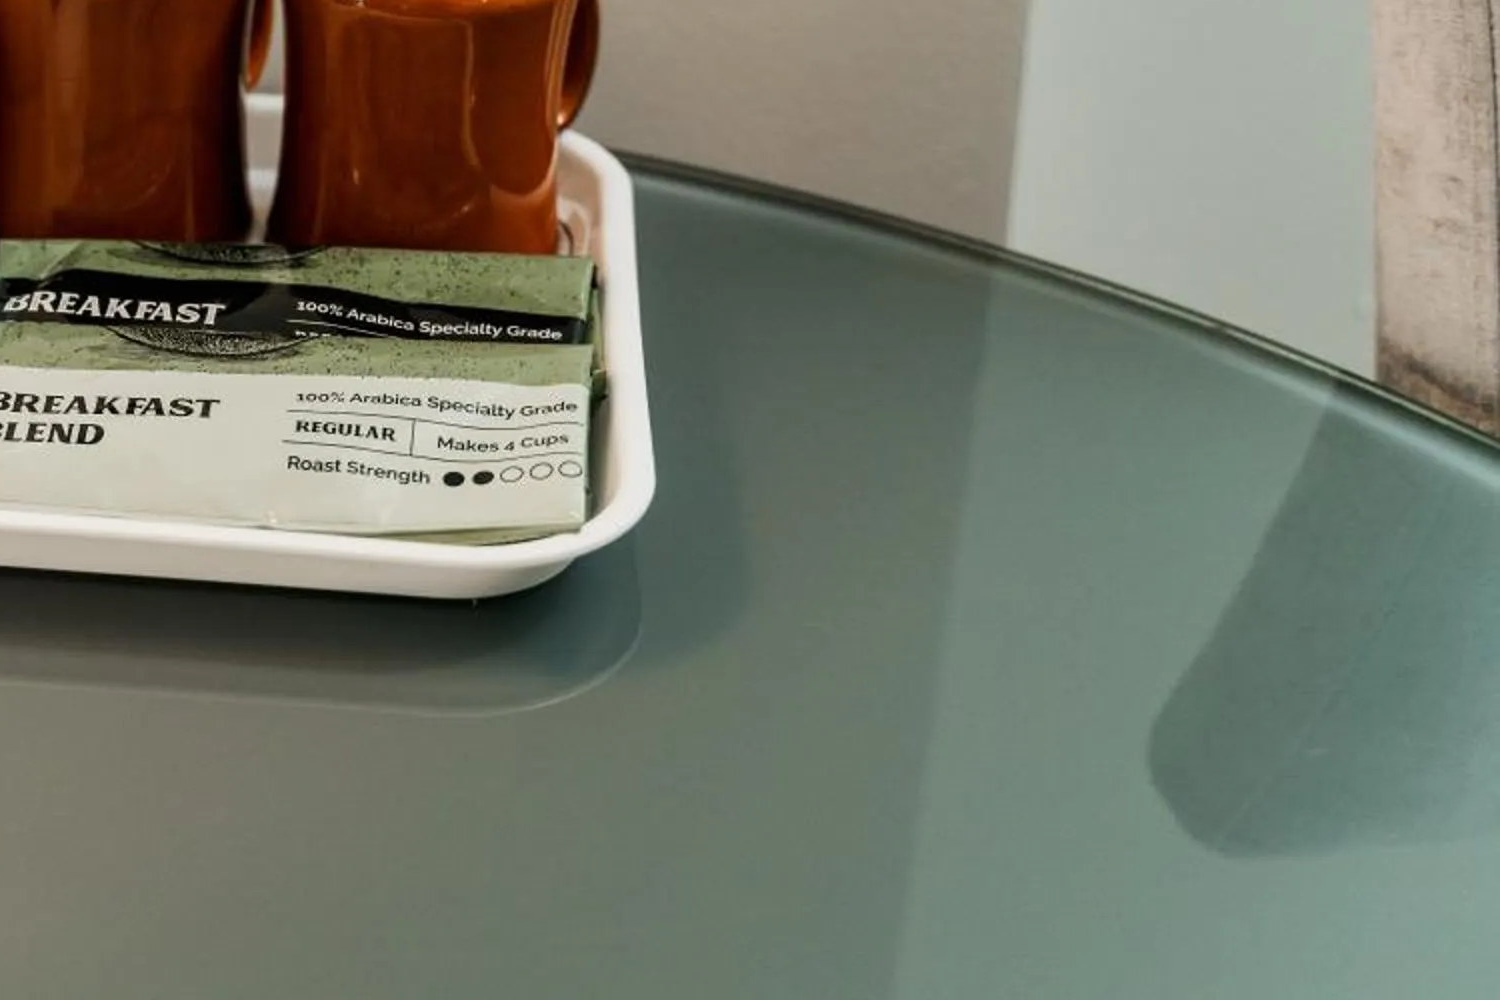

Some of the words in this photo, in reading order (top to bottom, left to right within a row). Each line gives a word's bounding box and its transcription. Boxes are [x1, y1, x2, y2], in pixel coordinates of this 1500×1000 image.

[3, 290, 226, 325] BREAKFAST
[296, 301, 343, 317] 100%
[346, 308, 415, 331] Arabica
[419, 320, 503, 338] Specialty
[506, 324, 563, 341] Grade
[296, 391, 345, 403] 100%
[349, 392, 422, 408] Arabica
[426, 395, 516, 420] Specialty
[518, 400, 579, 417] Grade
[294, 420, 397, 442] REGULAR
[437, 435, 500, 453] Makes
[503, 441, 516, 452] 4
[520, 433, 569, 449] Cups
[286, 455, 342, 474] Roast
[346, 460, 431, 485] Strength
